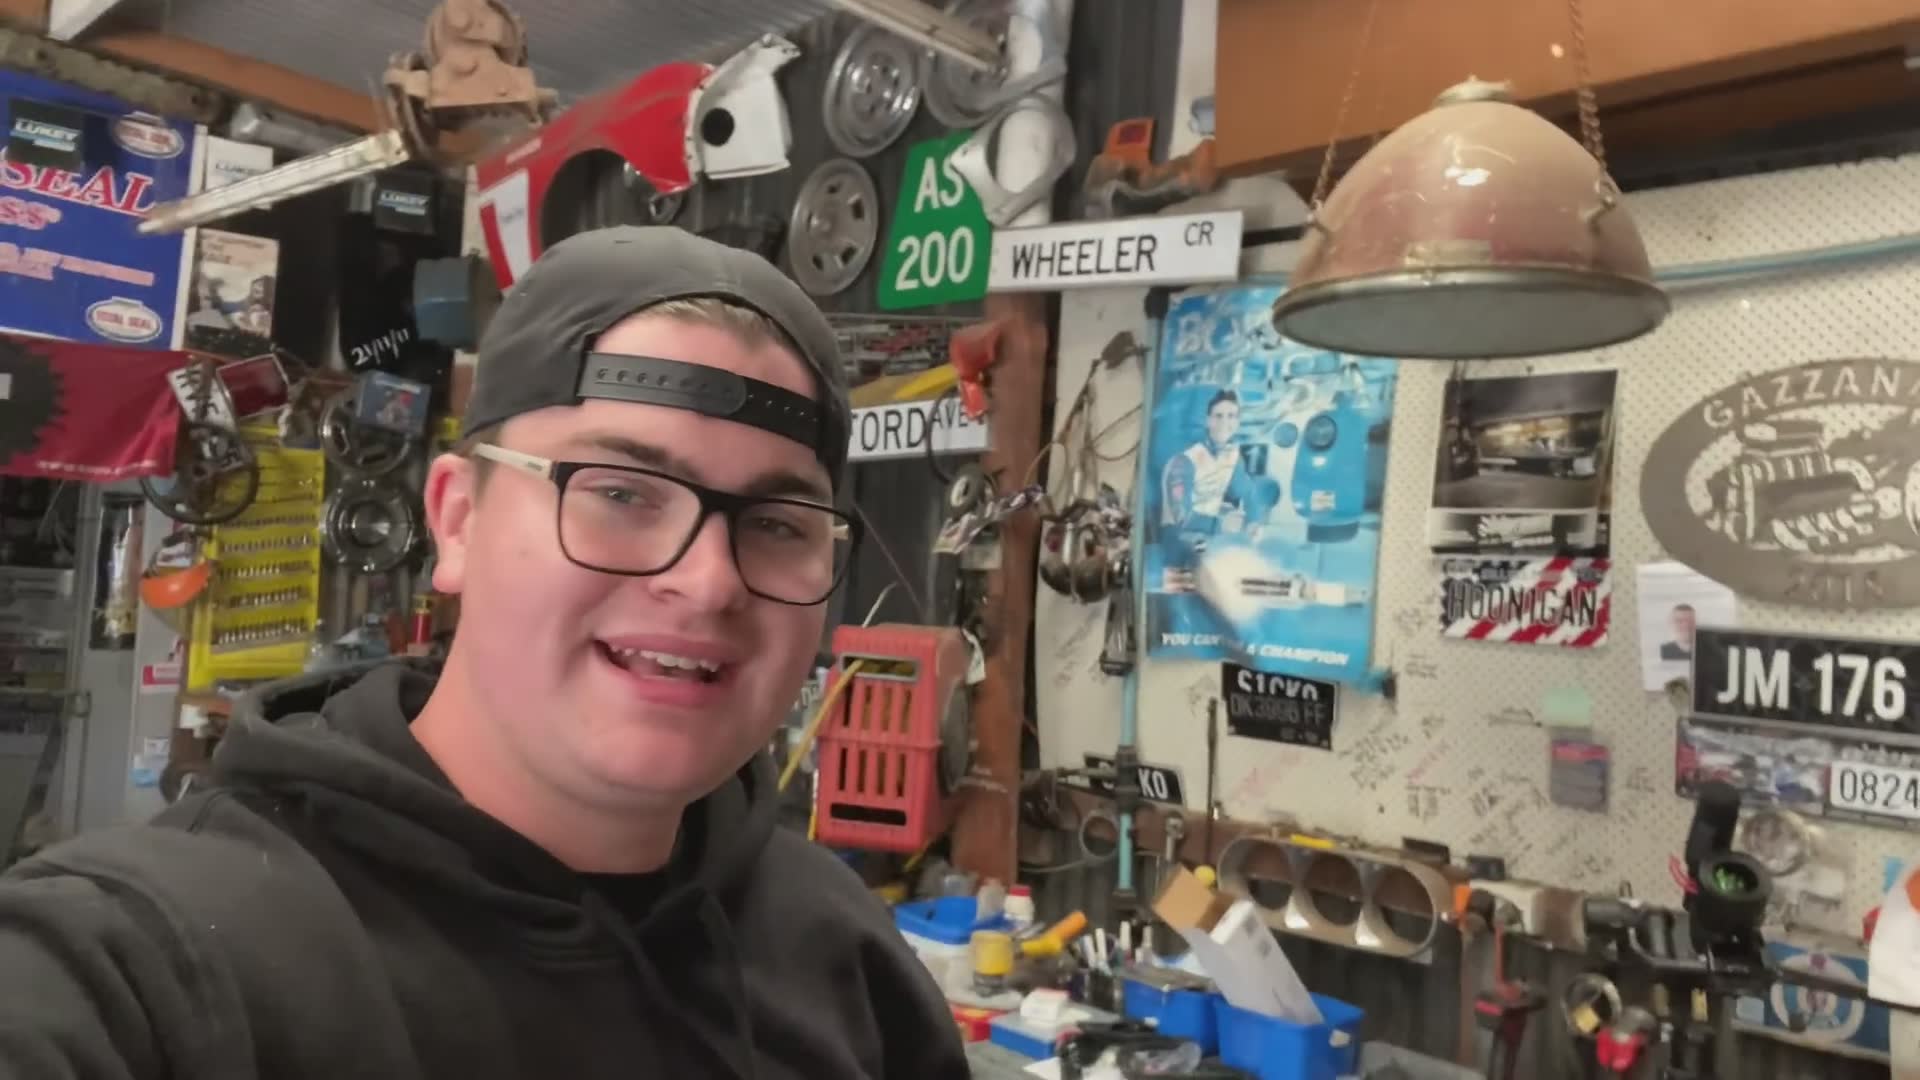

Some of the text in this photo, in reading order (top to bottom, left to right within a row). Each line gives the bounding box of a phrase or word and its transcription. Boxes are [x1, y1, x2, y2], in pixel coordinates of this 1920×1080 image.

[895, 226, 974, 291] 200
[1011, 221, 1214, 278] WHEELER CR
[852, 407, 927, 452] ORD
[1449, 577, 1597, 628] HOONIGAN
[1161, 632, 1191, 646] YOU
[1260, 644, 1349, 666] CHAMPION
[1717, 645, 1791, 711] JM
